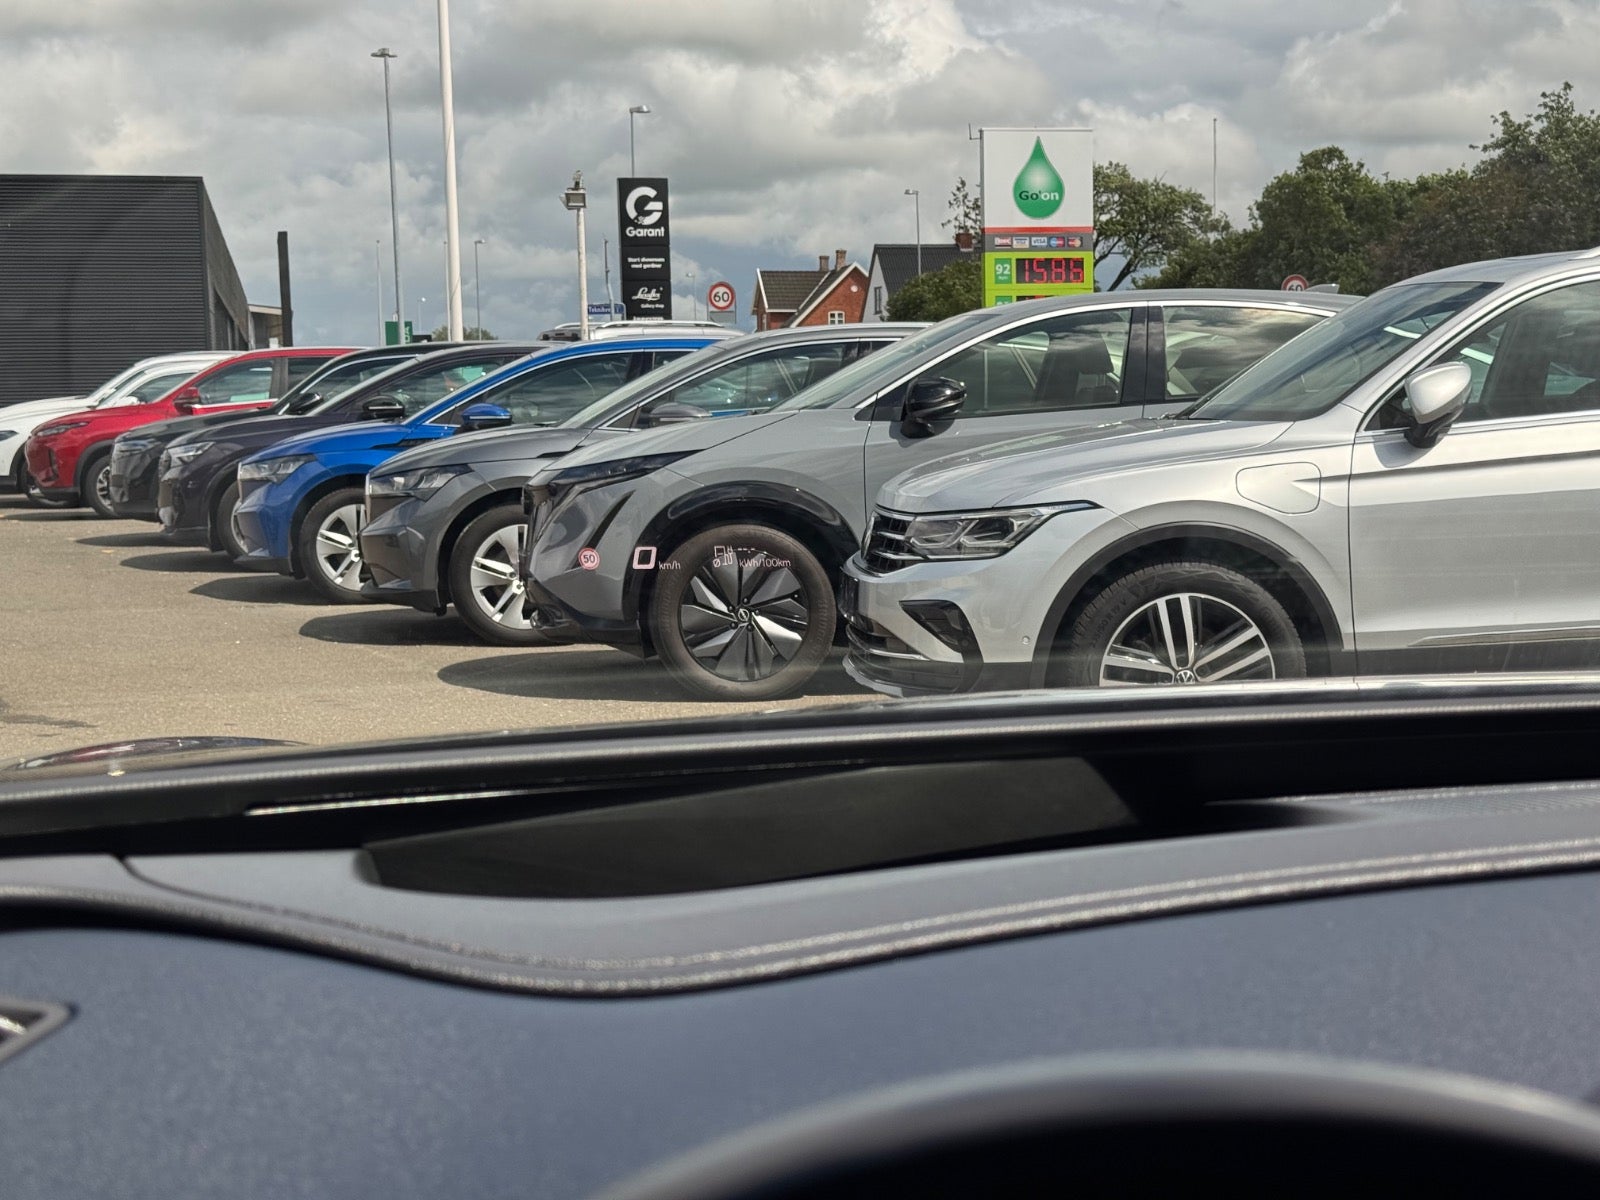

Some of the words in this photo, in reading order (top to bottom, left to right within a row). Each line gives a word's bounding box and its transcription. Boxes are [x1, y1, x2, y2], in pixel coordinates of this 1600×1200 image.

[626, 227, 665, 237] Garant
[995, 264, 1011, 275] 92
[713, 291, 730, 303] 60
[583, 554, 596, 564] 50
[632, 546, 658, 570] 0
[739, 558, 792, 567] kWh/100km
[658, 560, 681, 570] km/h
